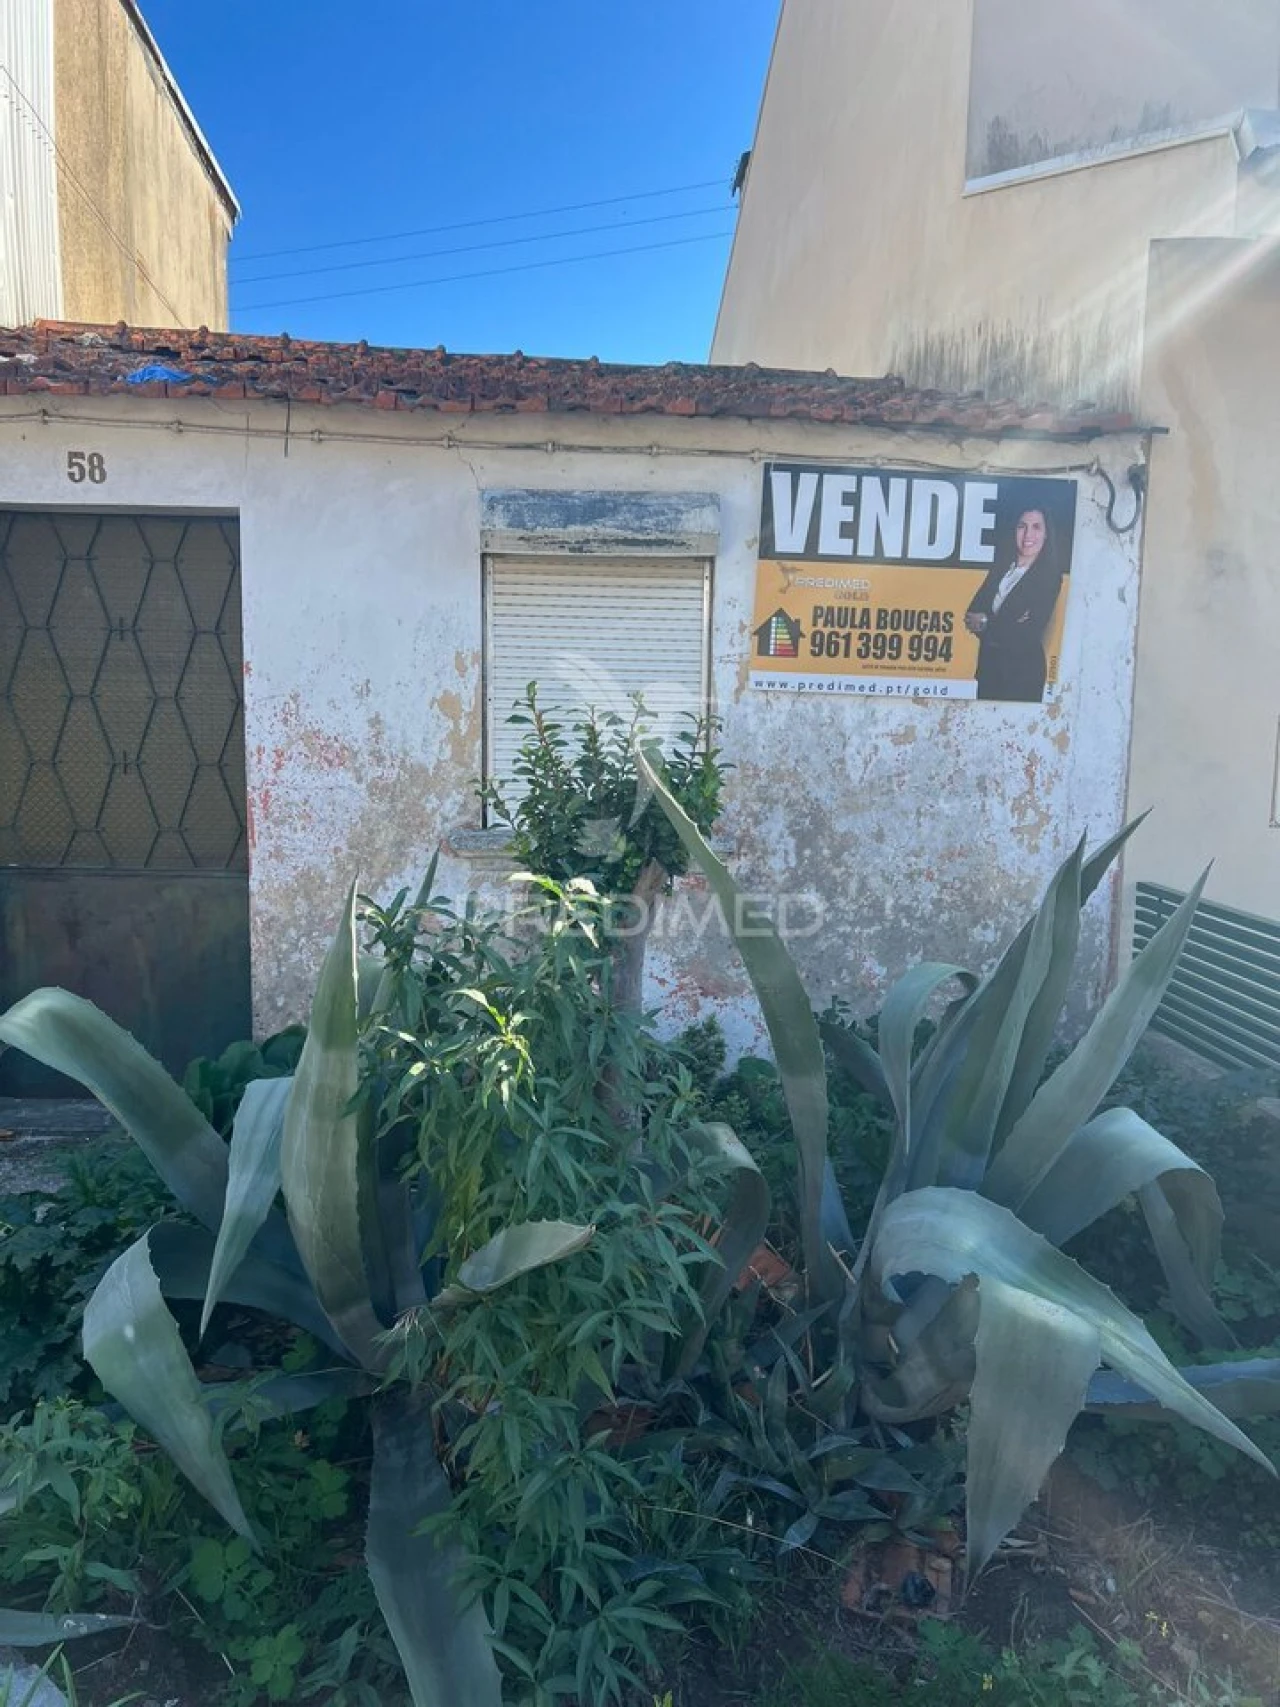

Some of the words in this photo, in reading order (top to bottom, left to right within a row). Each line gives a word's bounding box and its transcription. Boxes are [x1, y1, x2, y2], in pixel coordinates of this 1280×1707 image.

[67, 451, 107, 484] 58
[770, 471, 998, 563] VENDE
[795, 577, 873, 590] PREDIMED
[812, 605, 871, 630] PAULA
[876, 608, 954, 635] BOUÇAS
[810, 630, 851, 659] 961
[856, 632, 904, 661] 399
[907, 634, 954, 663] 994
[753, 679, 950, 697] www.predimed.pt/gold
